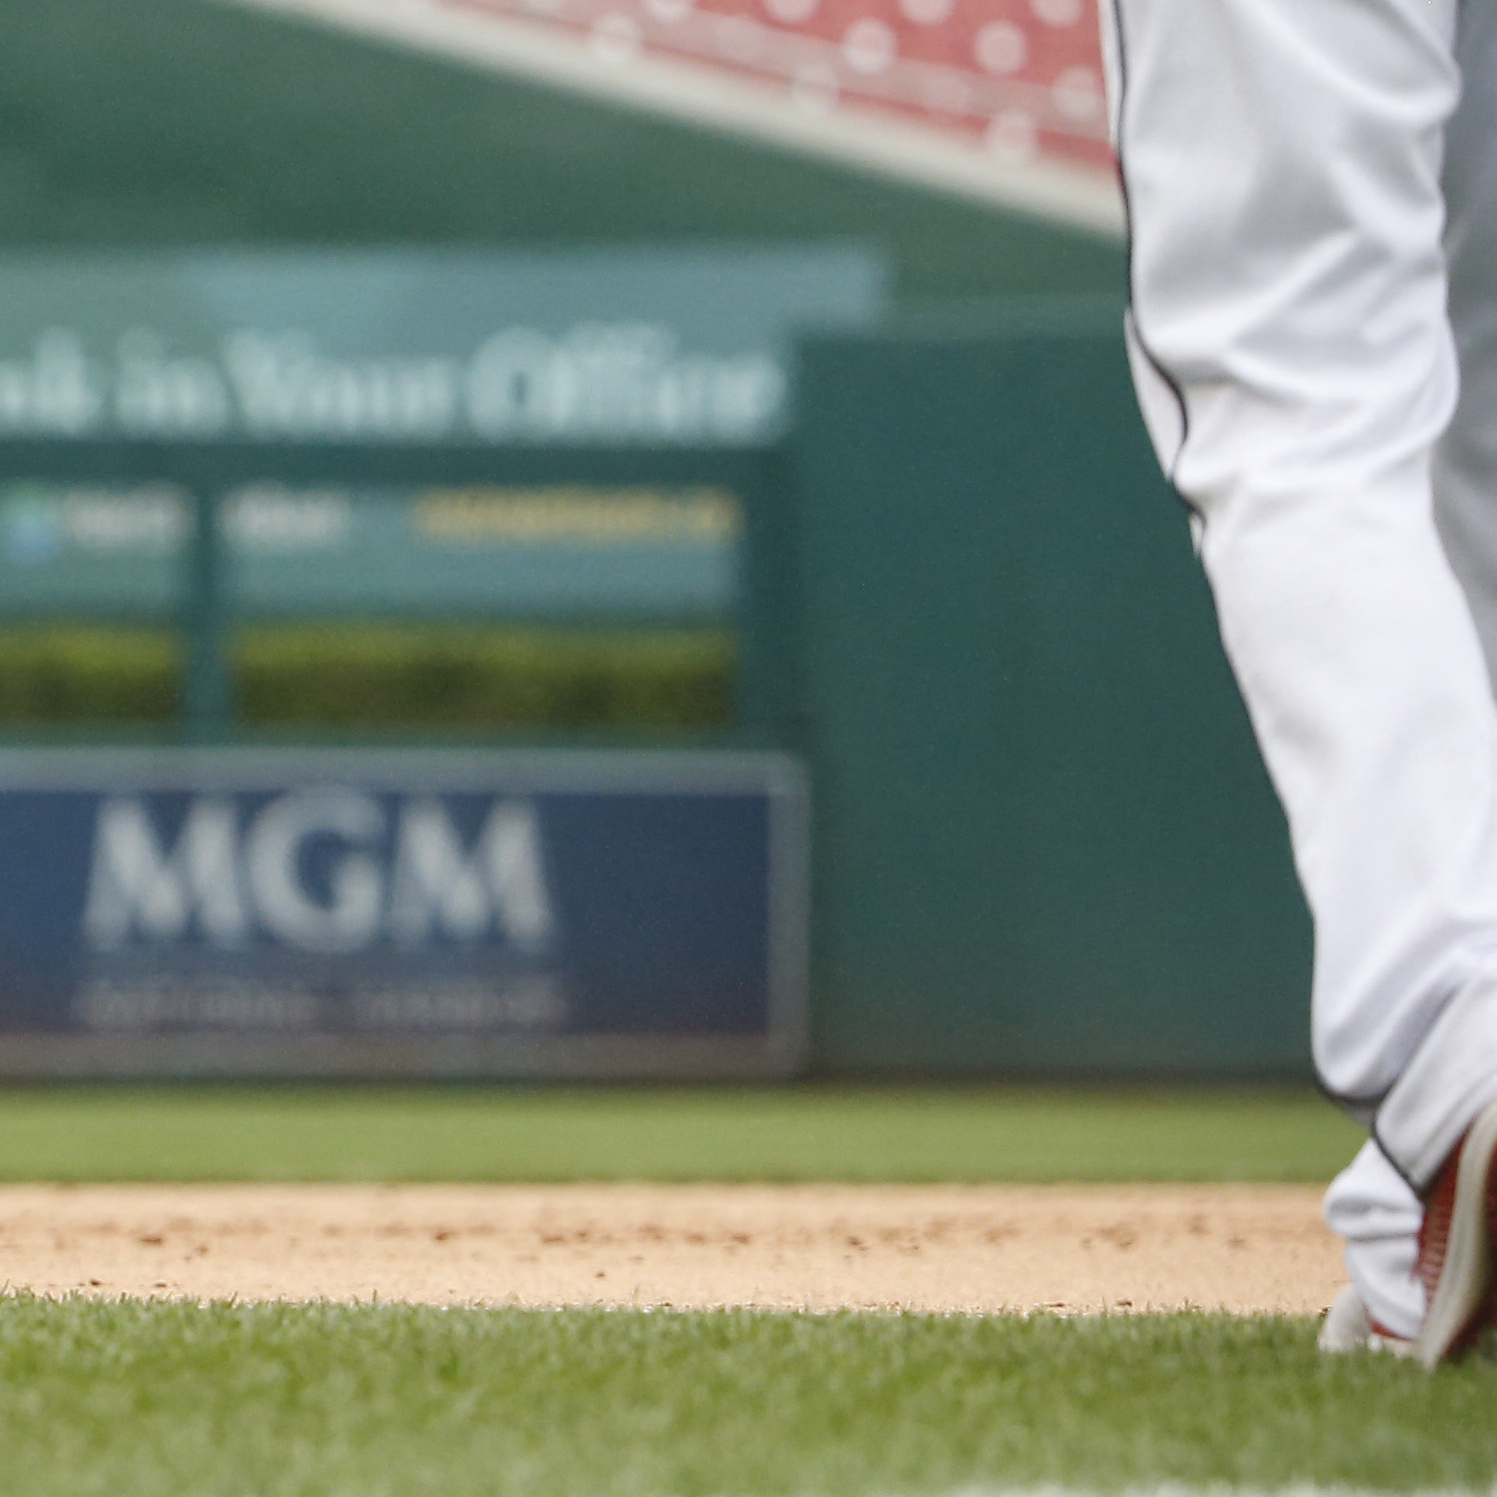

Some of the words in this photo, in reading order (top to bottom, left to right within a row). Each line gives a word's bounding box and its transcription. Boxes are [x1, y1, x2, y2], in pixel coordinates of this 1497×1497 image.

[114, 326, 228, 435] in
[223, 327, 462, 439] Your
[464, 323, 789, 445] Office
[83, 784, 554, 955] MGM
